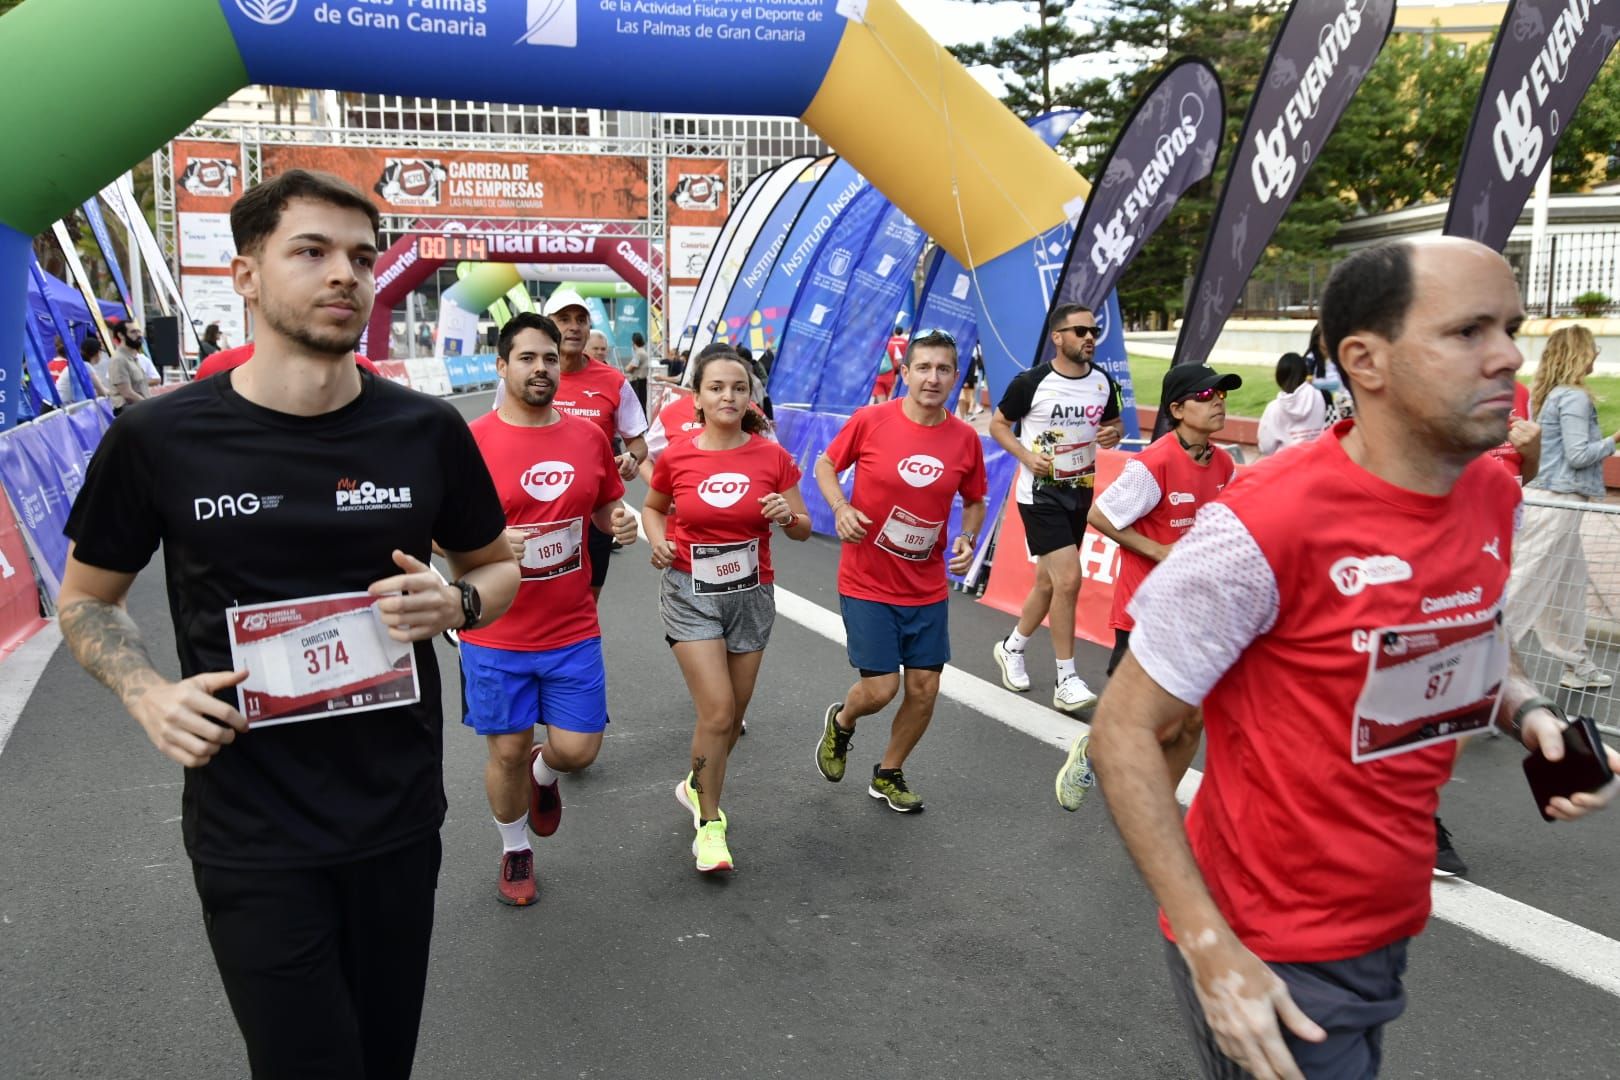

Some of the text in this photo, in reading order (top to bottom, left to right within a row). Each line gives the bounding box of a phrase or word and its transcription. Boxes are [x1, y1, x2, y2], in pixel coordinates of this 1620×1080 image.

[314, 3, 486, 36] de Gran Canaria
[599, 0, 616, 10] de
[620, 1, 631, 12] la
[633, 2, 691, 16] Actividad
[730, 8, 738, 21] y
[740, 8, 752, 19] el
[755, 9, 803, 22] Deporte
[807, 11, 823, 21] de
[616, 18, 806, 42] Las Palmas de Gran Canaria
[1530, 0, 1600, 107] EVEN
[1285, 0, 1361, 139] EVENTOS
[449, 161, 529, 180] CARRERA DE
[1124, 115, 1197, 223] EVENTOS
[449, 179, 544, 199] LAS EMPRESAS
[827, 173, 866, 216] INSULA
[443, 222, 602, 254] narias7
[571, 408, 600, 417] EMPRESAS
[1050, 403, 1104, 419] Aruca
[194, 493, 260, 520] DAG
[537, 541, 563, 560] 1876
[904, 533, 925, 546] 1875
[716, 561, 741, 577] 5805
[301, 628, 340, 648] CHRISTIAN
[303, 639, 350, 675] 374
[1424, 670, 1454, 700] 87
